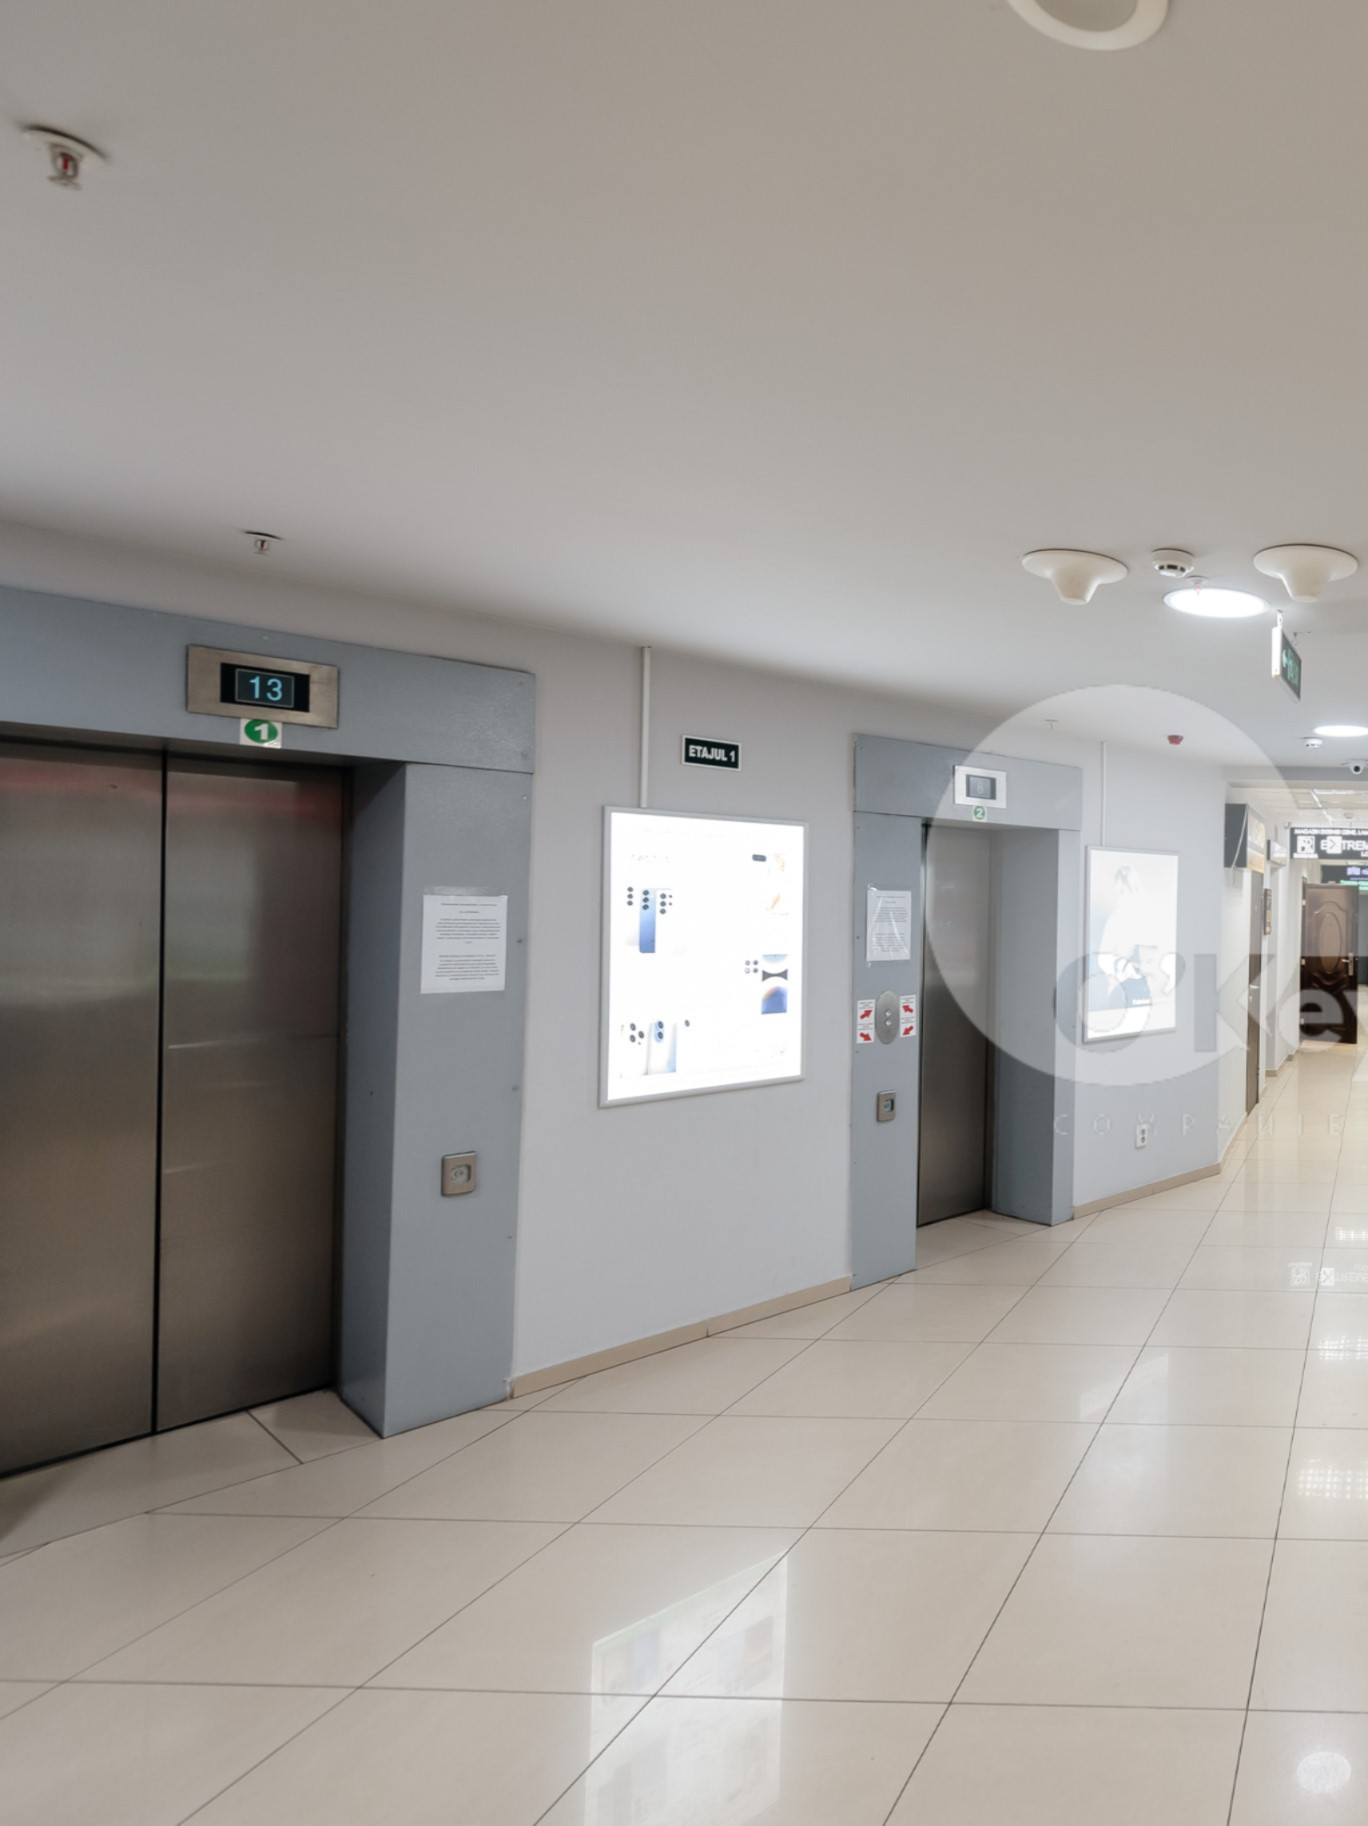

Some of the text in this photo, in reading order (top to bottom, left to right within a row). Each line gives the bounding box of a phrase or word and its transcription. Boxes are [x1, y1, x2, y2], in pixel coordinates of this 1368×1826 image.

[248, 675, 283, 701] 13
[254, 723, 270, 740] 1
[688, 744, 736, 762] ETAJUL 1
[976, 807, 983, 819] 2
